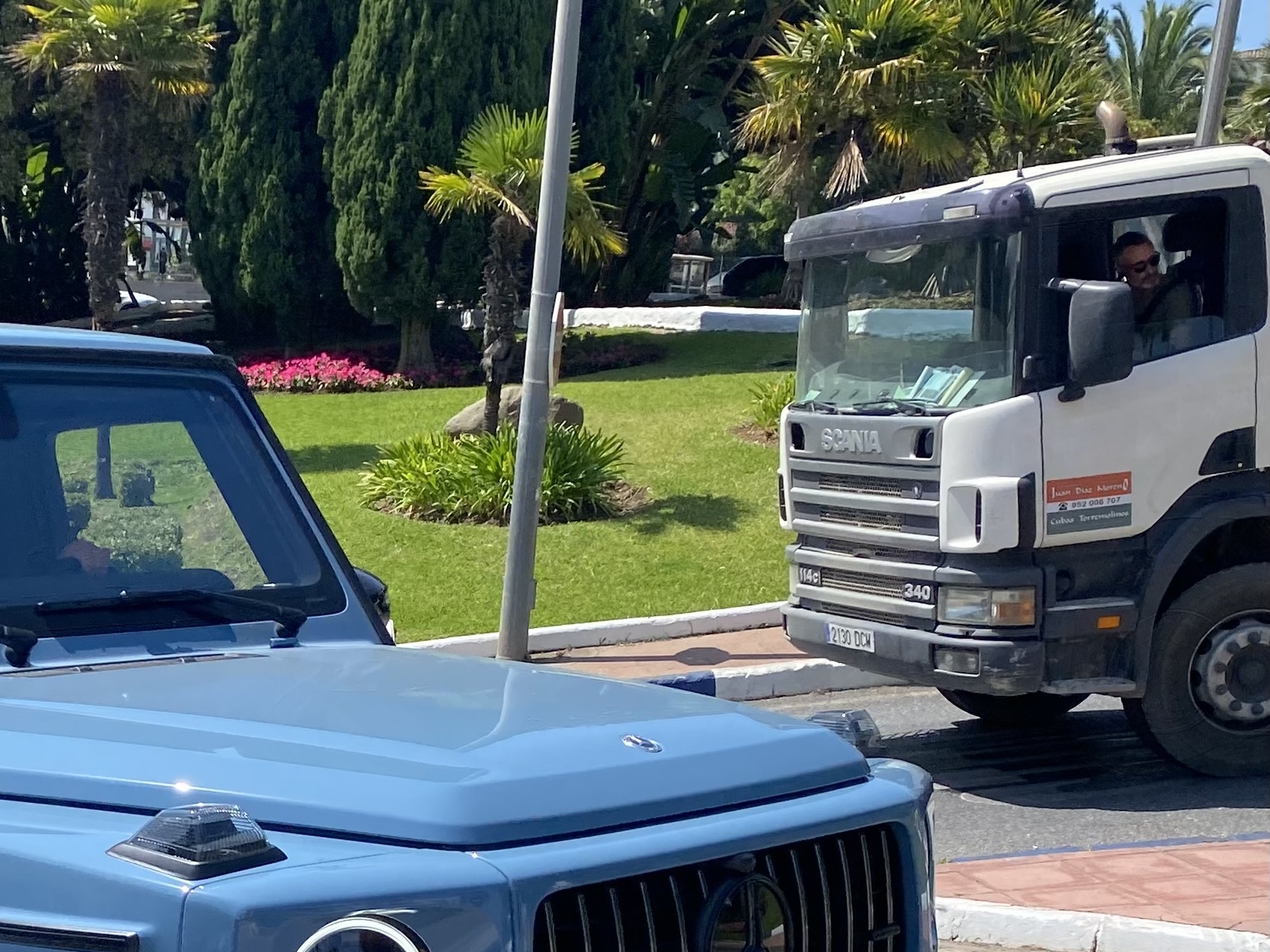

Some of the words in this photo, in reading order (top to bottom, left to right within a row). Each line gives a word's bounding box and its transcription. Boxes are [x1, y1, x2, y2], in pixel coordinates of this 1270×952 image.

[821, 428, 882, 453] SCANIA
[1051, 487, 1071, 499] Juan
[1106, 496, 1121, 504] 707
[1050, 516, 1075, 525] Cubas
[904, 583, 931, 601] 340
[831, 626, 852, 646] 2130
